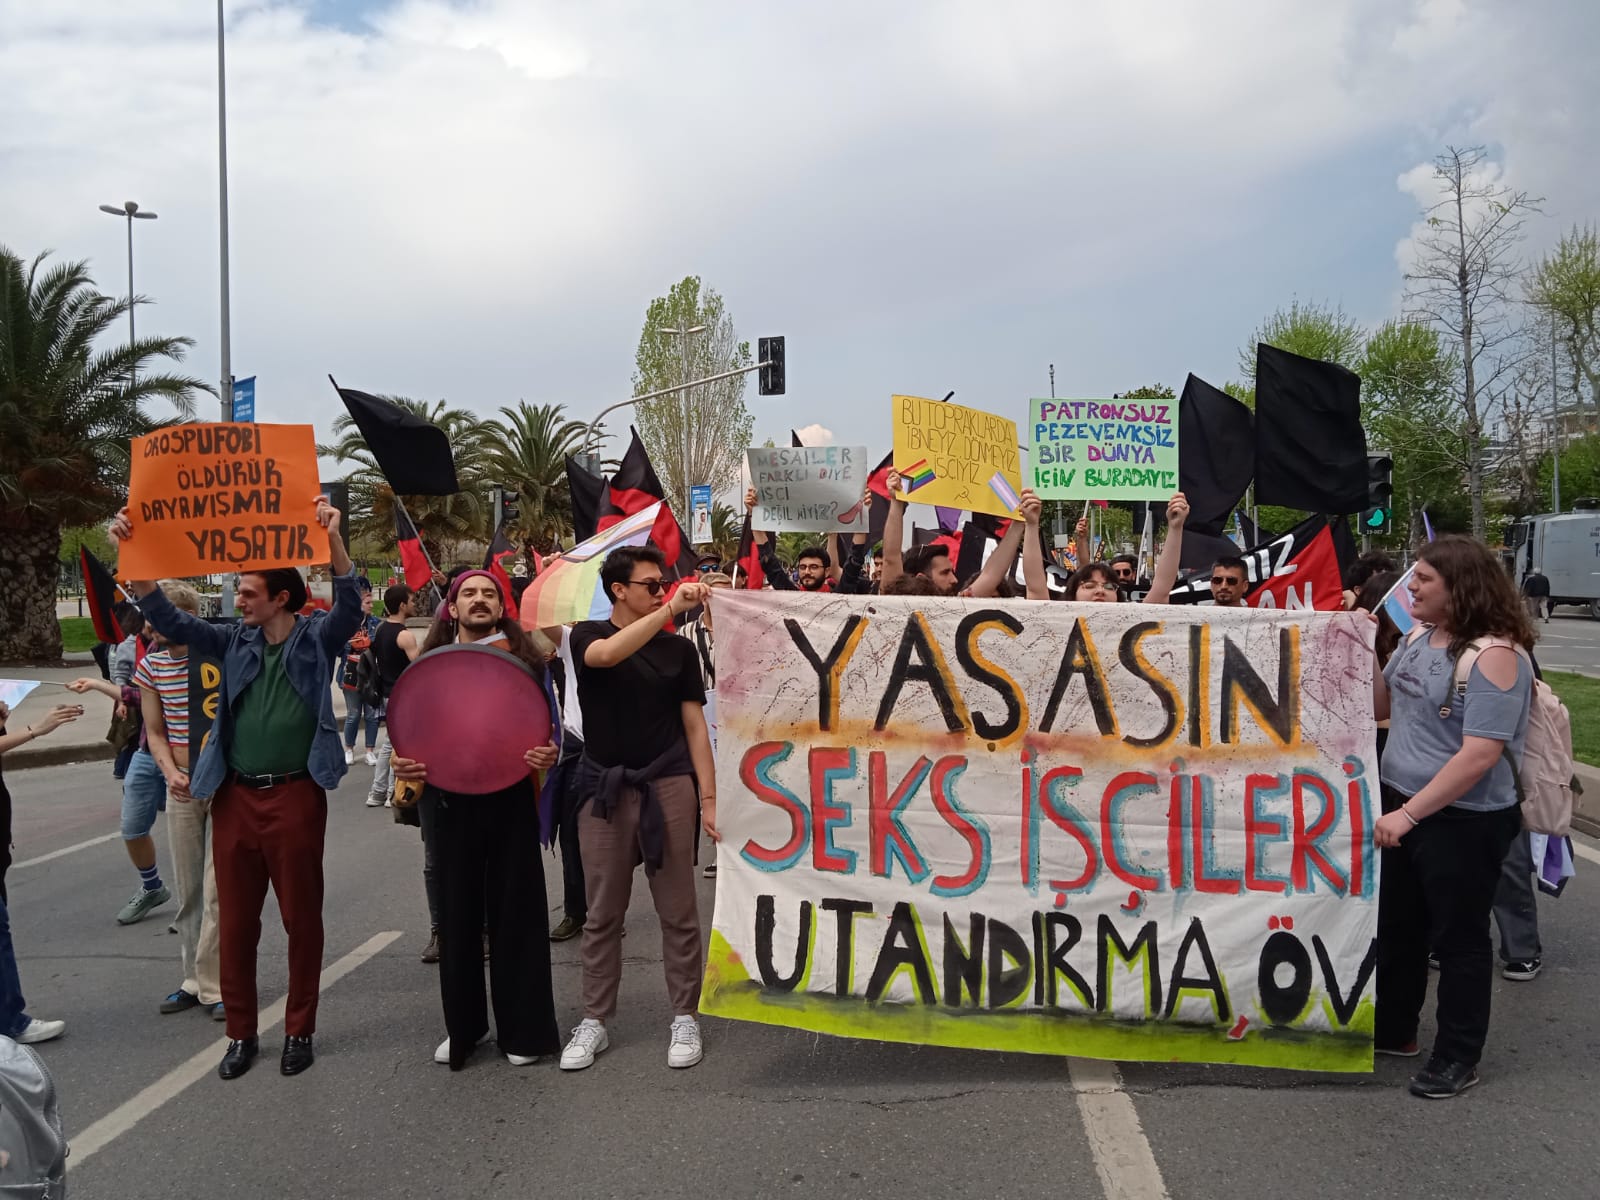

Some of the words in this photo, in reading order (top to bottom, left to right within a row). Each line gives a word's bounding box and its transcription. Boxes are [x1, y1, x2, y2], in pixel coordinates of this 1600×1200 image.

[902, 399, 921, 425] BU
[1040, 401, 1171, 424] PATRONSUZ
[1035, 423, 1175, 448] PEZEVENKSİZ
[1039, 442, 1075, 464] BİR
[1088, 442, 1155, 464] DÜNYA
[177, 459, 282, 490] ÖLDÜRÜR
[1035, 467, 1076, 488] İÇİN
[141, 489, 281, 522] DAYANIŞMA
[186, 525, 313, 568] YAŞATIR
[739, 740, 992, 897] SEKS
[1020, 746, 1373, 915] İŞÇİLERİ
[1257, 914, 1376, 1027] ÖV
